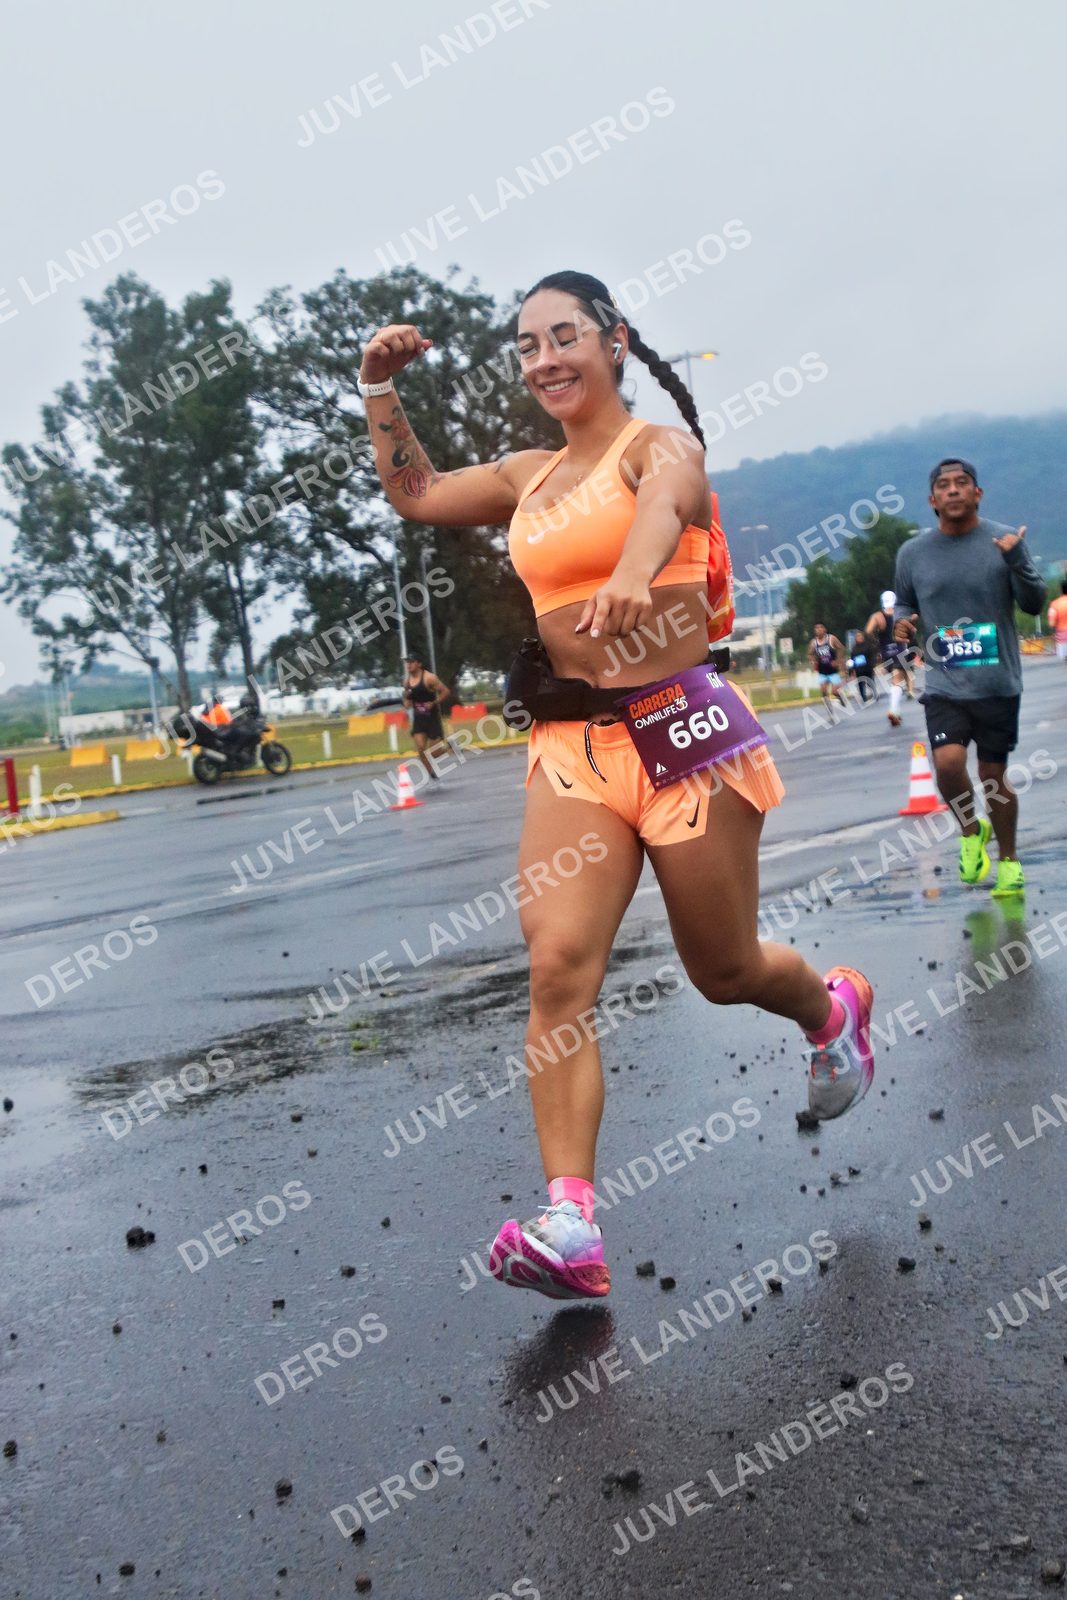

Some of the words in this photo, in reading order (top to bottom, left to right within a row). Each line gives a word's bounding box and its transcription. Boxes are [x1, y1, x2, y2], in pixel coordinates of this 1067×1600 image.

[946, 641, 983, 657] 1626
[705, 671, 725, 689] 15K
[628, 682, 685, 719] CARRERA
[668, 704, 730, 749] 660
